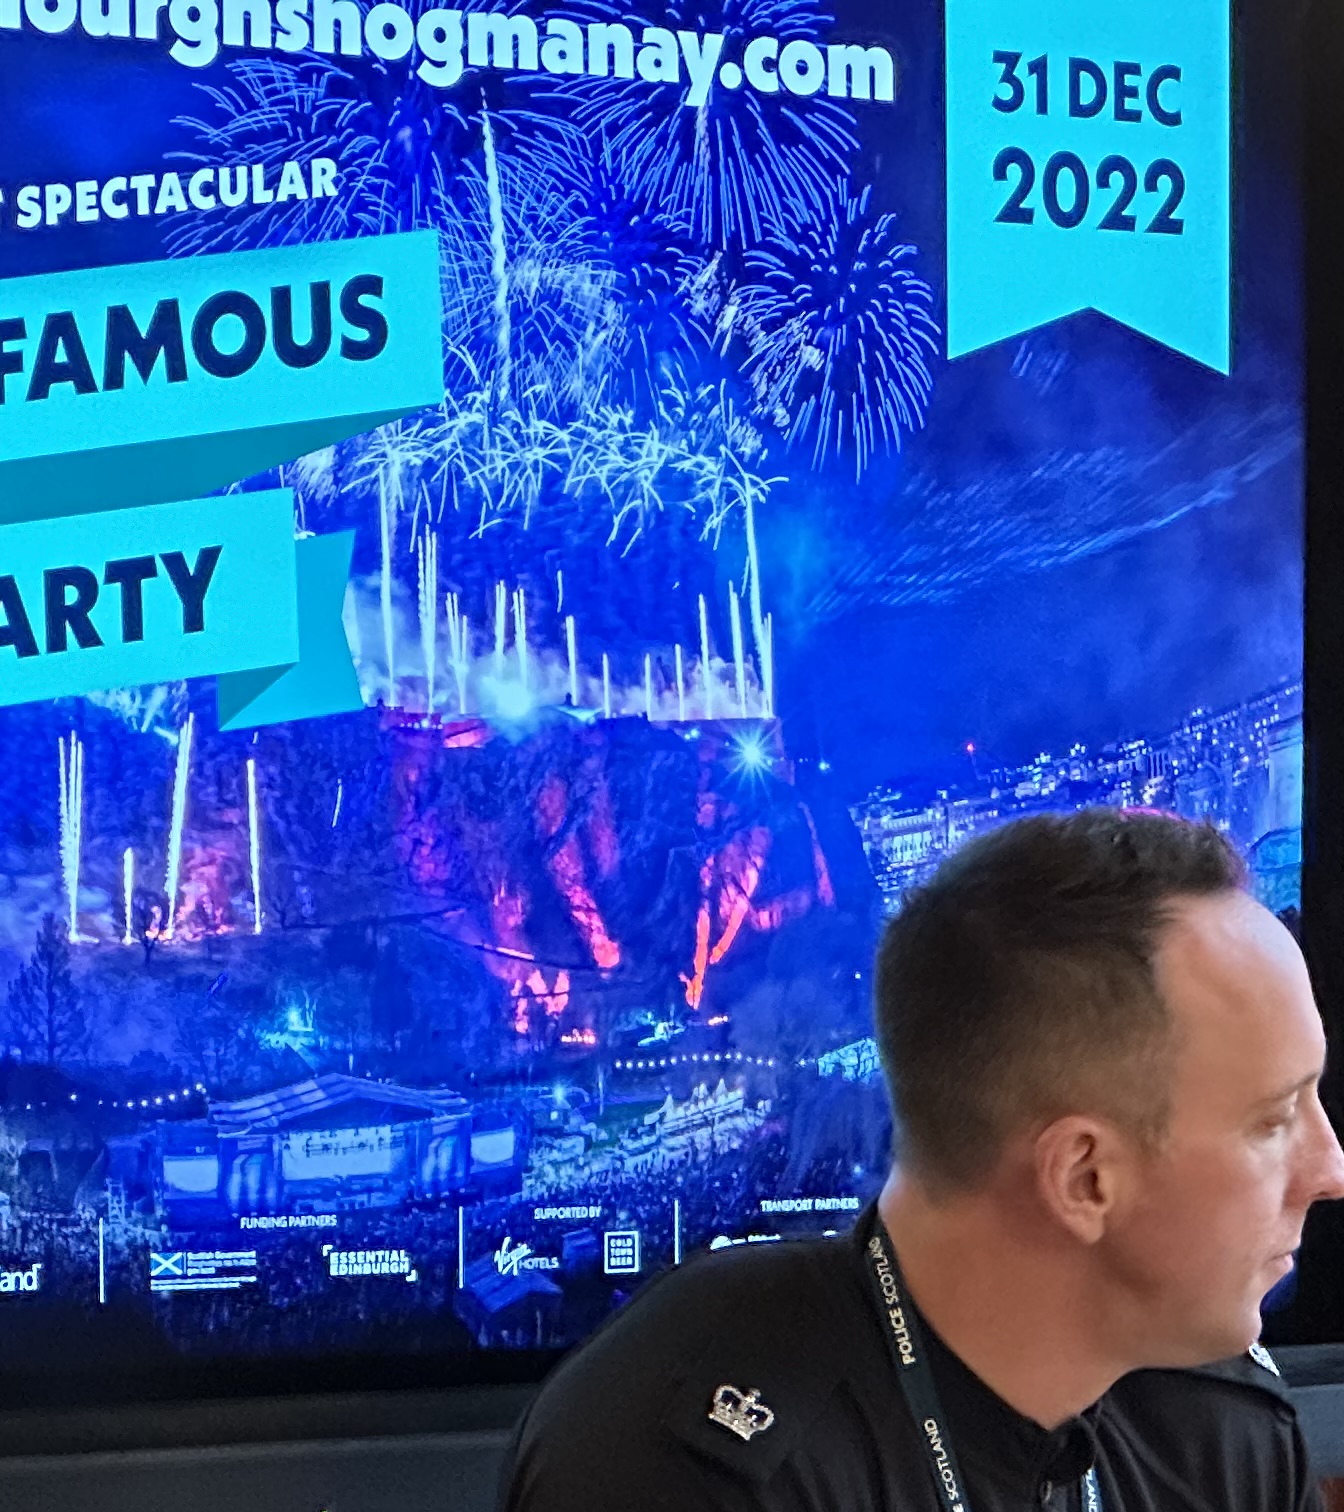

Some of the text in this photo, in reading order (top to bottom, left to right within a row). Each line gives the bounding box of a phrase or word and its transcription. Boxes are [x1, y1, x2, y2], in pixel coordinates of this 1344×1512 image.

[992, 49, 1182, 127] 31 DEC
[16, 157, 338, 228] SPECTACULAR
[992, 145, 1185, 235] 2022
[0, 274, 388, 405] FAMOUS
[534, 1205, 602, 1220] SUPPORTED BY
[760, 1200, 813, 1212] TRANSPORT
[240, 1217, 288, 1229] FUNDING
[494, 1236, 532, 1276] Virgin
[610, 1238, 633, 1248] COLD
[329, 1250, 408, 1265] ESSENTIAL
[329, 1262, 410, 1276] EDINBURGH
[518, 1257, 560, 1270] HOTELS
[888, 1307, 917, 1365] POLICE
[924, 1419, 959, 1501] SCOTLAND
